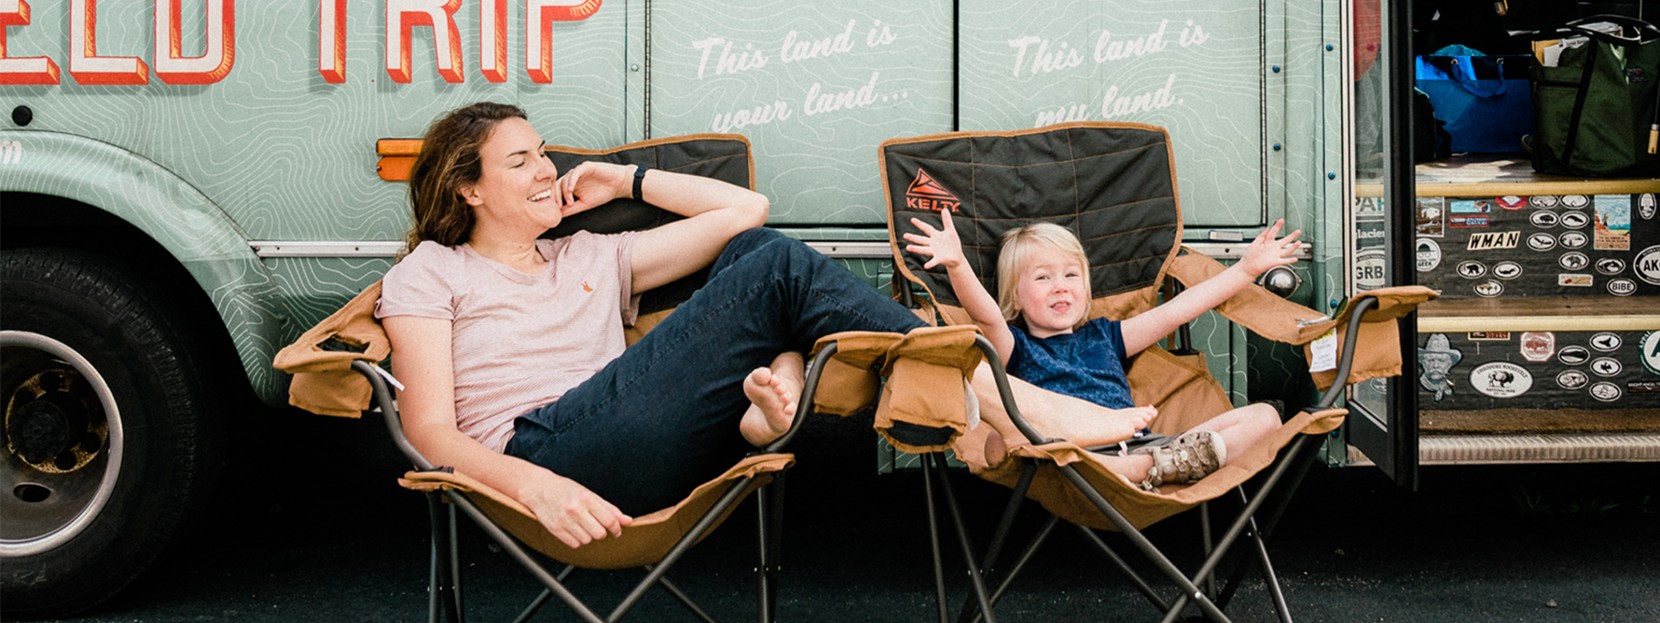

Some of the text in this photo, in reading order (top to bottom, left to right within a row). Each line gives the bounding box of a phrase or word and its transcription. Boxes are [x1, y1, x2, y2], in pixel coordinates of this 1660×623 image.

[692, 19, 897, 80] This land is
[1007, 18, 1210, 78] This land is
[1101, 73, 1184, 119] land.
[711, 99, 792, 134] your
[906, 197, 961, 213] KELTY
[1355, 229, 1385, 239] lacier
[1470, 232, 1519, 249] WMAN
[1356, 265, 1385, 280] GRB
[1643, 259, 1660, 272] AK
[1612, 282, 1632, 291] BIBE
